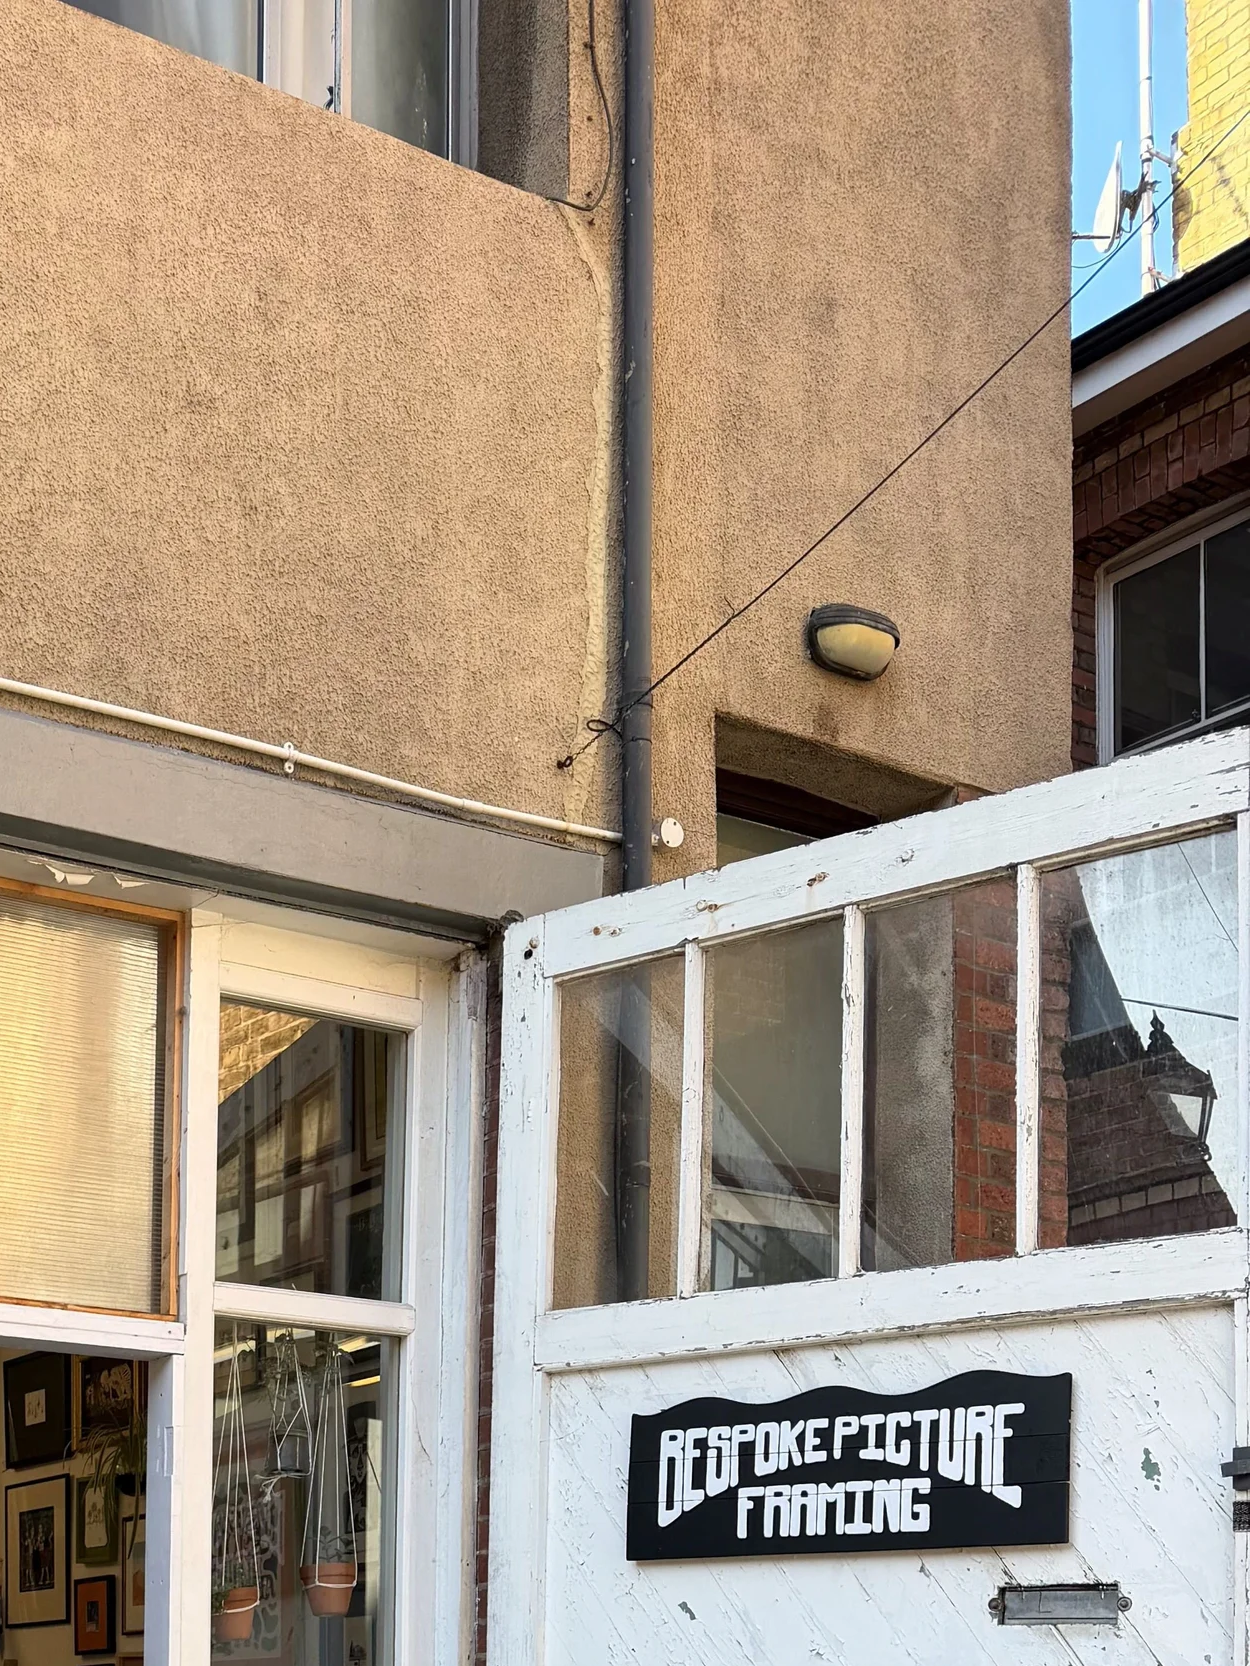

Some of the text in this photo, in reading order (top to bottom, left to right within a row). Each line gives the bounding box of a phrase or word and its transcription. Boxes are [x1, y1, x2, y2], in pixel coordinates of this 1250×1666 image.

[657, 1402, 1025, 1528] BESPOKE PICTURE
[737, 1477, 931, 1539] FRAMING
